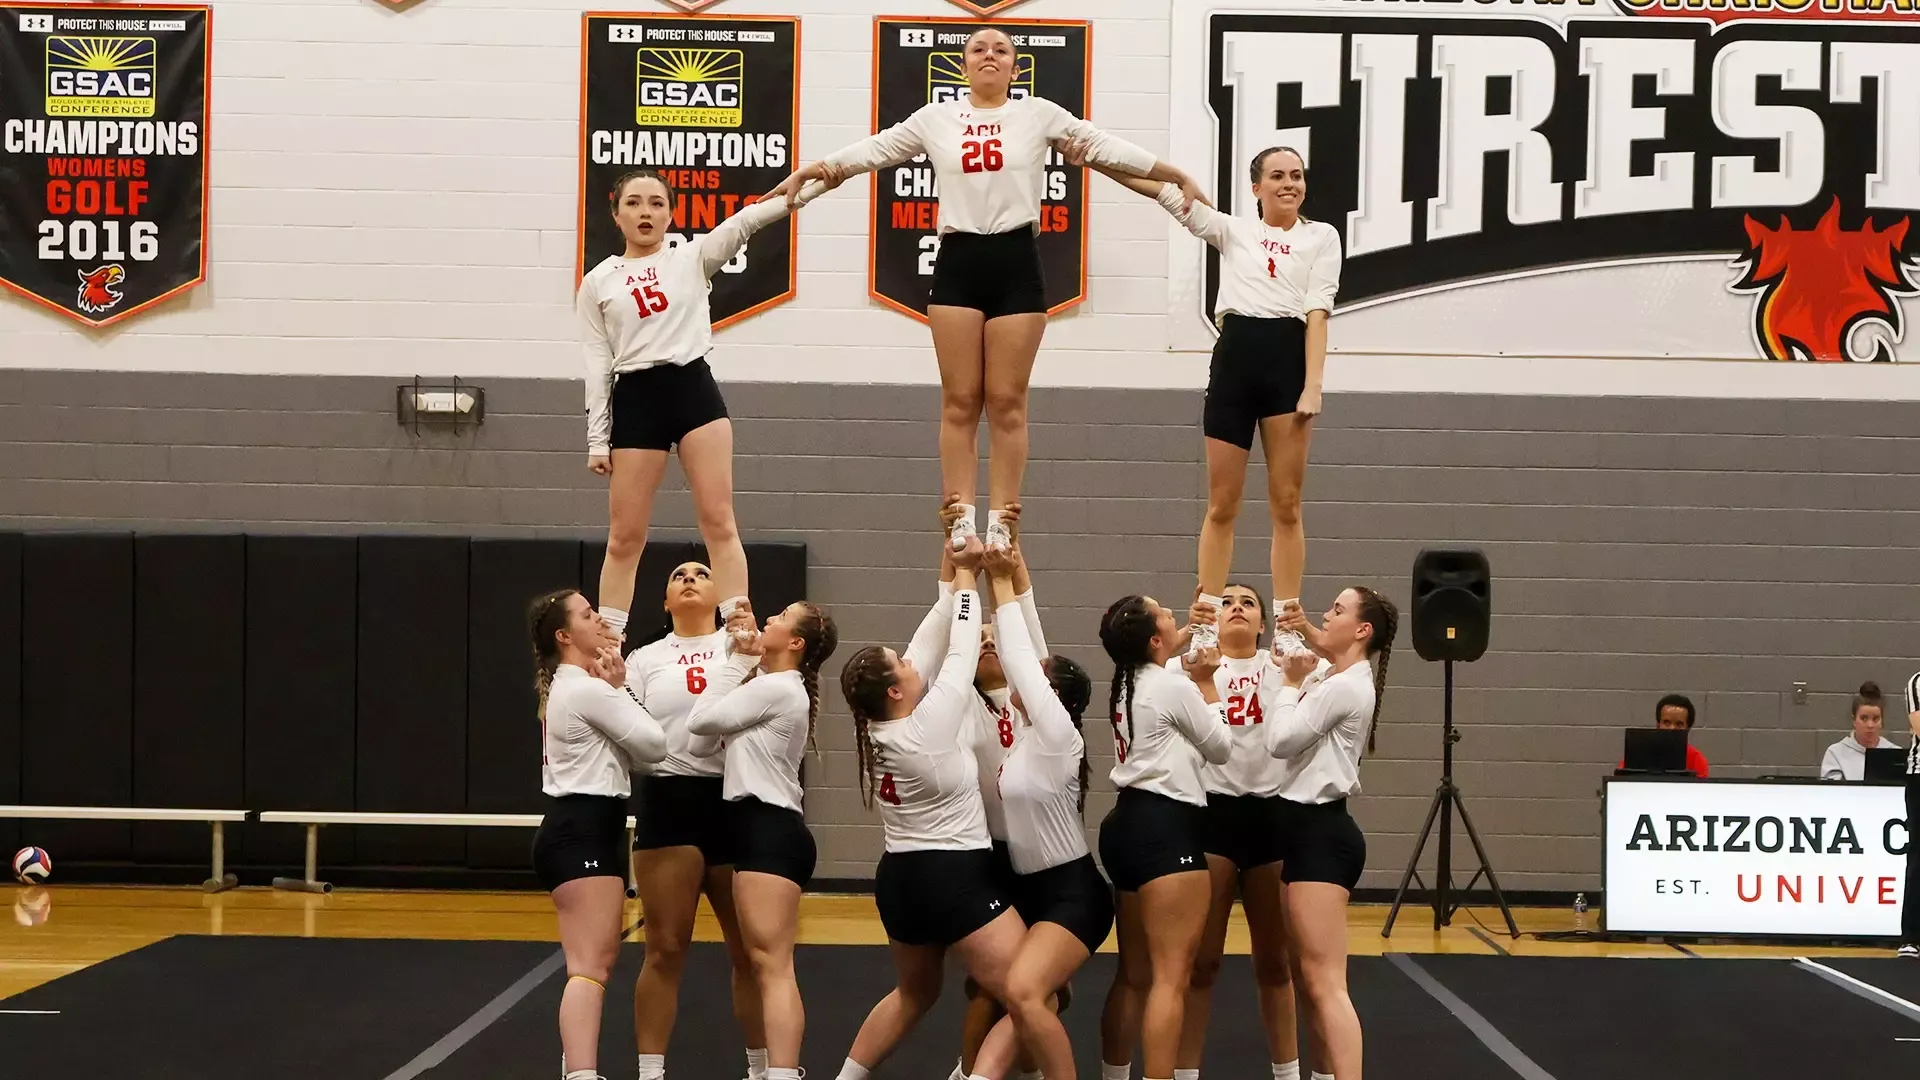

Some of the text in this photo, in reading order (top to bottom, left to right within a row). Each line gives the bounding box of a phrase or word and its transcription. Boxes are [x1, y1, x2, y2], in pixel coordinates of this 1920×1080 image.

[57, 18, 97, 30] PROTECT
[98, 19, 114, 30] THIS
[646, 28, 685, 40] PROTECT
[687, 29, 703, 41] THIS
[50, 71, 151, 97] GSAC
[641, 81, 738, 107] GSAC
[50, 105, 150, 114] CONFERENCE
[640, 114, 737, 124] CONFERENCE
[4, 119, 198, 155] CHAMPIONS
[962, 124, 1001, 136] ACU
[591, 130, 787, 168] CHAMPIONS
[961, 139, 1004, 174] 26
[47, 157, 146, 178] WOMENS
[46, 180, 149, 216] GOLF
[38, 220, 158, 261] 2016
[631, 280, 669, 319] 15
[686, 666, 707, 695] 6
[1227, 692, 1263, 726] 24
[997, 718, 1014, 749] 8
[880, 772, 902, 806] 4
[1625, 813, 1864, 854] ARIZONA
[1655, 879, 1709, 895] EST.
